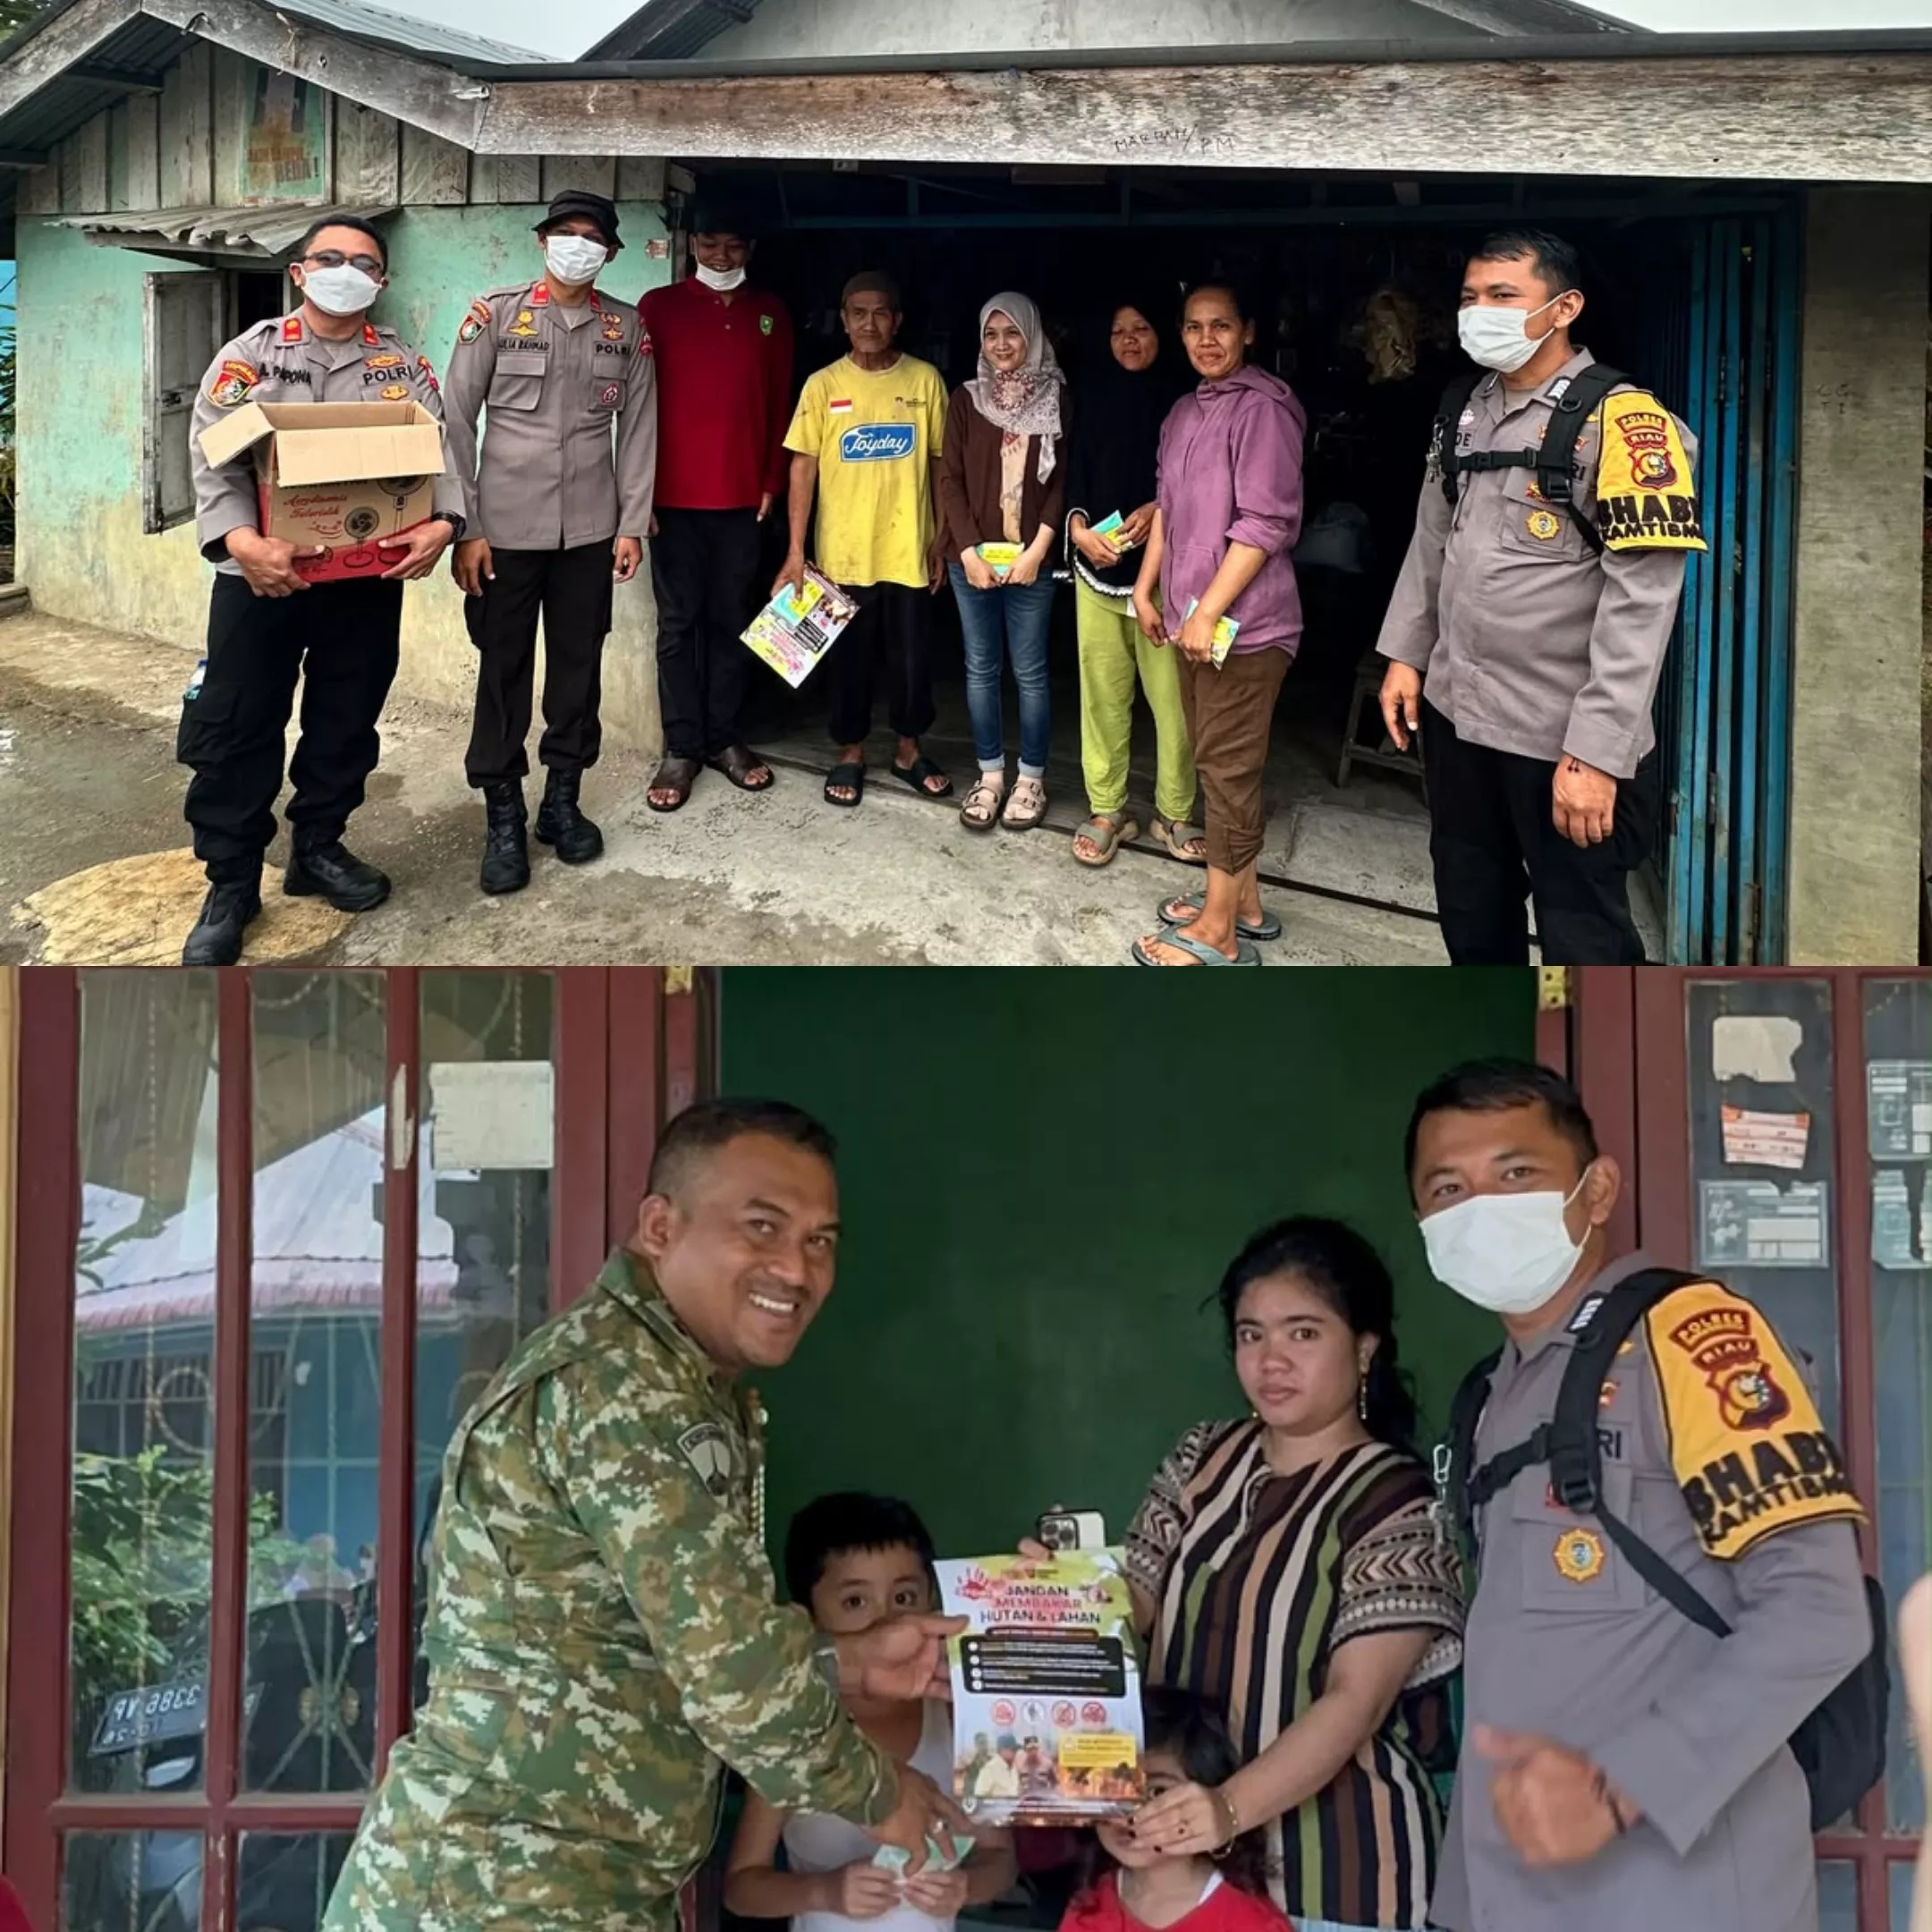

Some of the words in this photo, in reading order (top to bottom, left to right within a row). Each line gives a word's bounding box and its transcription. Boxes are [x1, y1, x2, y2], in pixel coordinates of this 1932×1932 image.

[363, 365, 413, 385] POLRI
[844, 428, 908, 454] Joyday
[1631, 433, 1664, 444] RIAU
[1701, 1341, 1751, 1364] RIAU
[1703, 1475, 1855, 1551] KAMTIBM
[980, 1610, 1034, 1623] HUTAN
[1051, 1612, 1101, 1624] LAHAN
